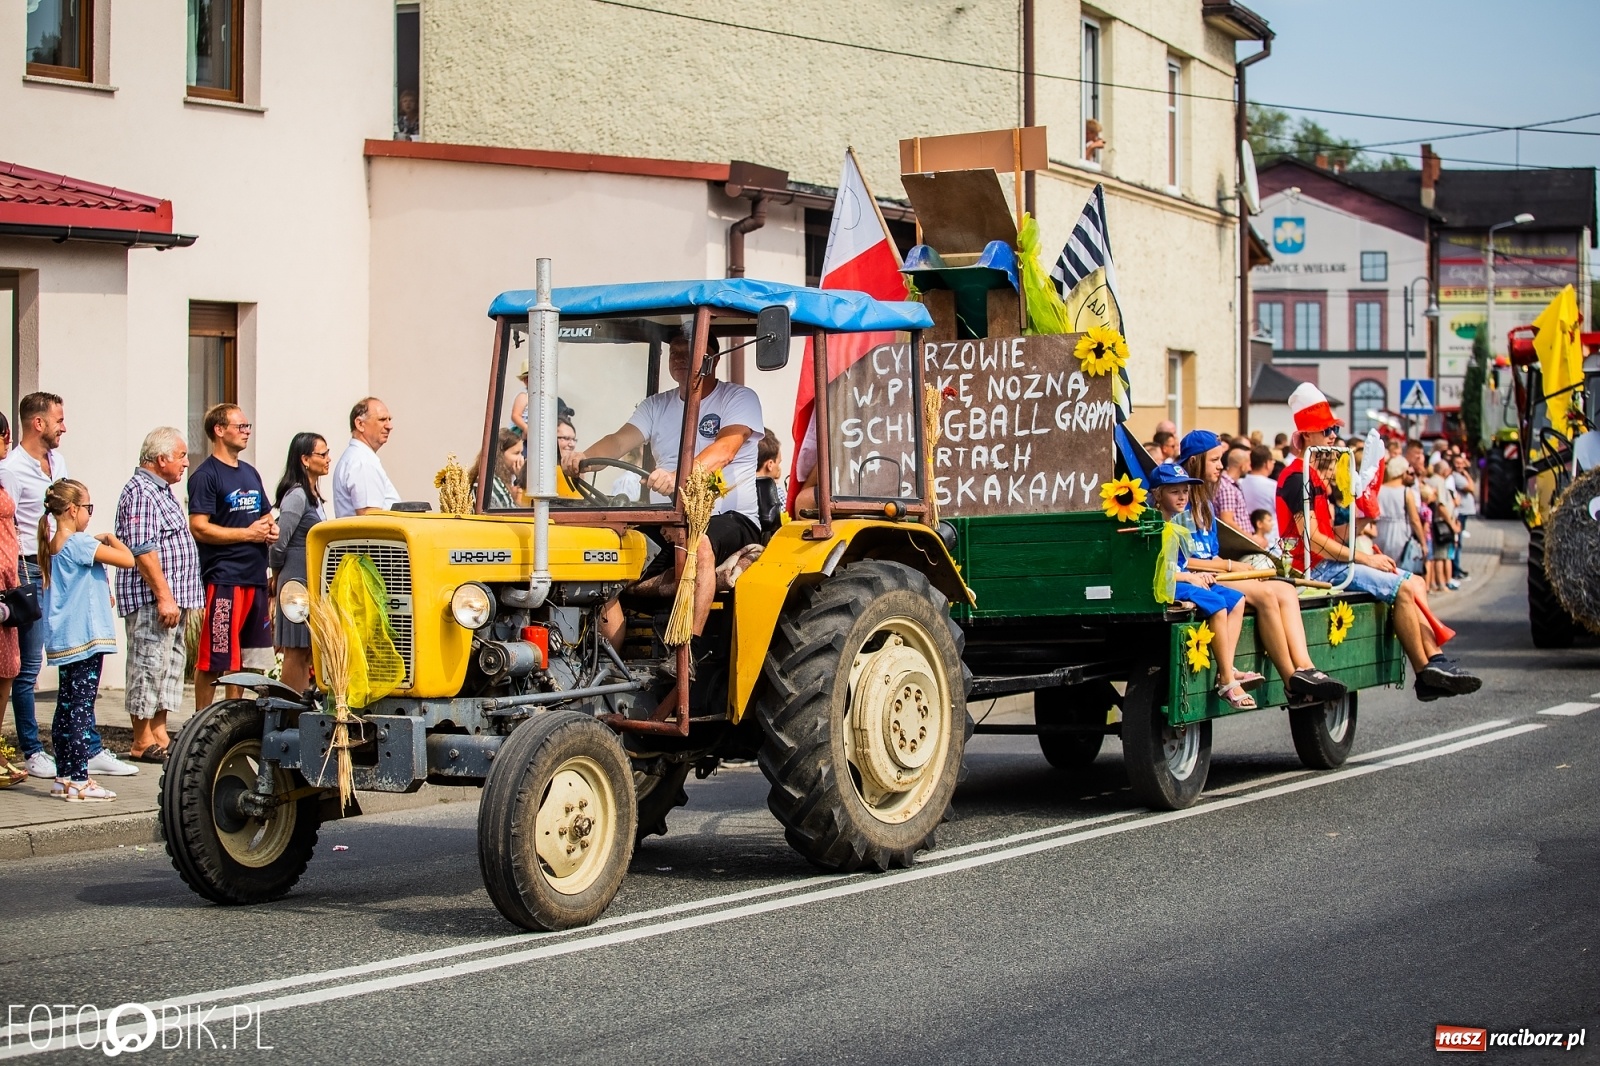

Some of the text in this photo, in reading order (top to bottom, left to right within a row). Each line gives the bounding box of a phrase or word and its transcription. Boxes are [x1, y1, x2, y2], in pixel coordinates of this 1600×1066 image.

[1304, 263, 1347, 273] WIELKIE
[853, 382, 875, 408] W
[888, 373, 975, 408] PIKĘ
[841, 402, 1051, 448] SCHLGBALL
[849, 450, 881, 484] NA
[900, 443, 1032, 476] NRTACH
[900, 471, 1099, 508] PSKAKAMY
[452, 551, 511, 563] URSUS
[584, 551, 618, 562] C-330
